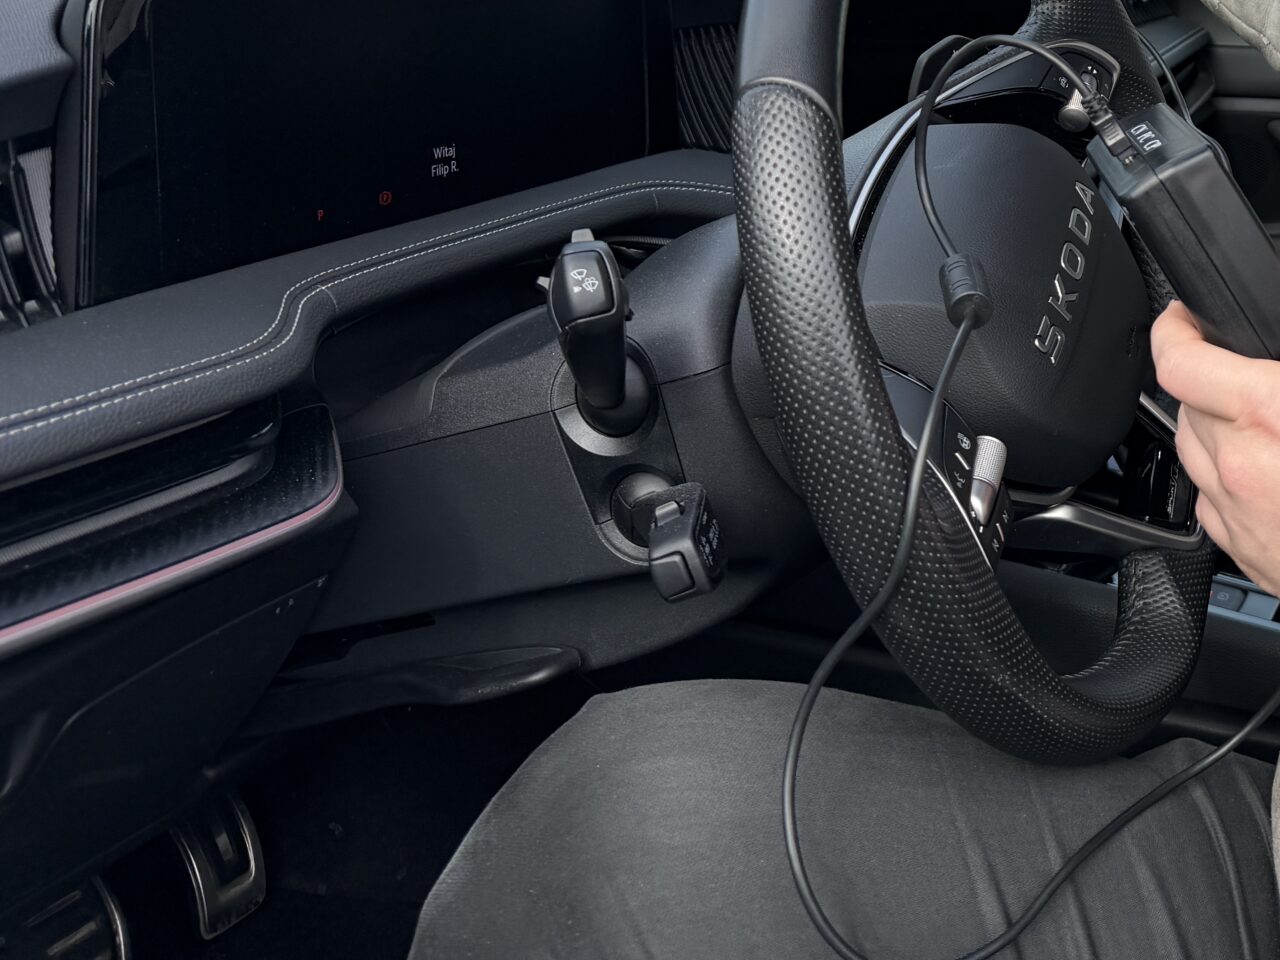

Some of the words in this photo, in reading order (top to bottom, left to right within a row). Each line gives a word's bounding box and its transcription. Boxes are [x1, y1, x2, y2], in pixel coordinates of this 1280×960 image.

[433, 144, 456, 160] Witaj
[431, 163, 449, 177] Filip
[451, 161, 459, 172] R.
[317, 209, 324, 221] P
